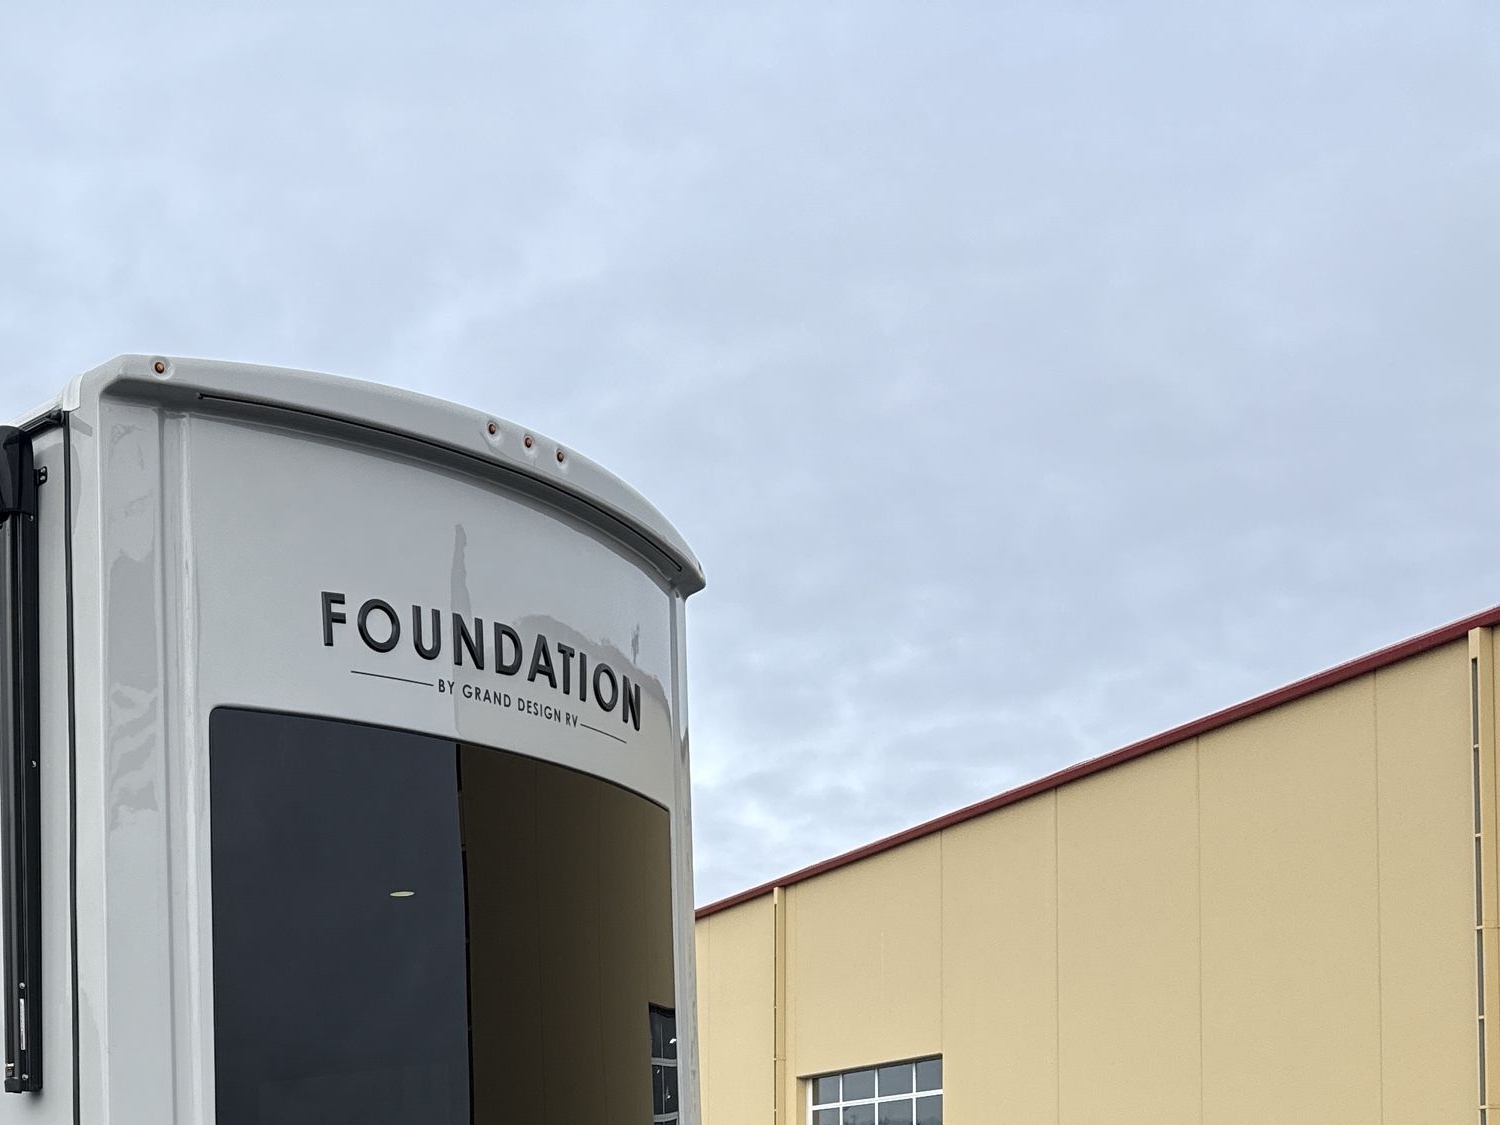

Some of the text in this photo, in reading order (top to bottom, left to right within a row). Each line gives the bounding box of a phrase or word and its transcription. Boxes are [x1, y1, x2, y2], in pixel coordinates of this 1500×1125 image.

[320, 590, 642, 731] FOUNDATION
[438, 678, 579, 728] BY GRAND DESIGN RV
